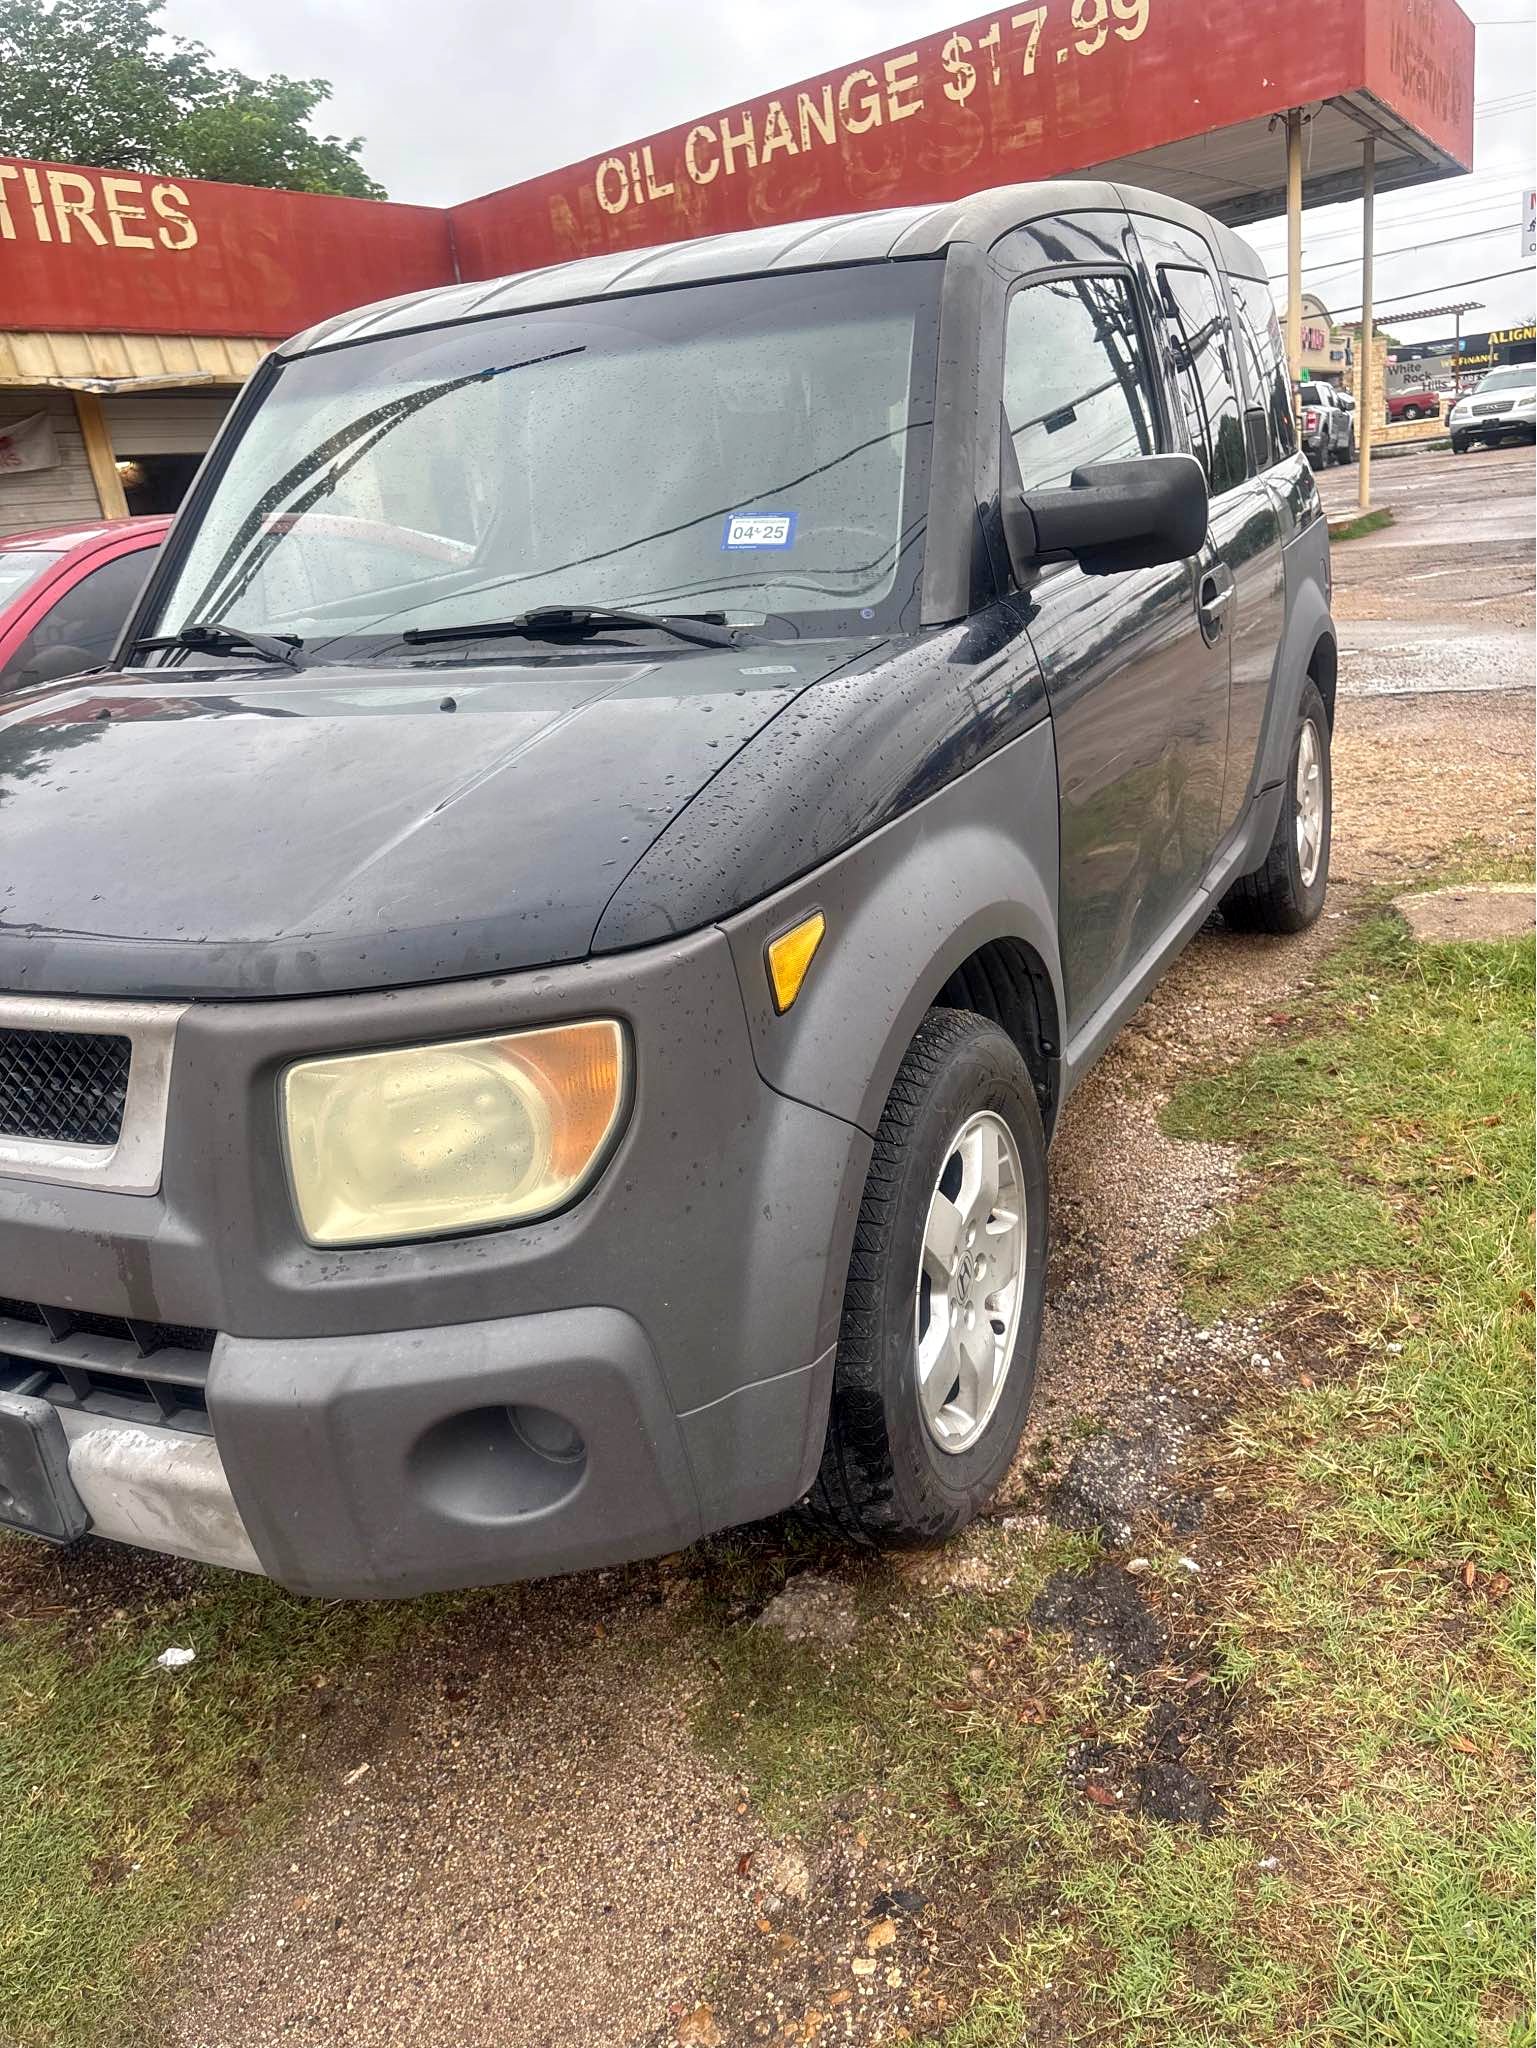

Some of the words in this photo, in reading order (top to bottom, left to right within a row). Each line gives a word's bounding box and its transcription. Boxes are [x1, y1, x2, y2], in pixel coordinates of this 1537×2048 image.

[595, 145, 675, 214] OIL
[685, 52, 925, 185] CHANGE
[941, 0, 1150, 108] $17.99
[0, 165, 199, 250] TIRES
[1488, 327, 1536, 345] ALIGN
[1387, 363, 1422, 376] White
[1403, 371, 1432, 384] Rock
[1422, 380, 1448, 392] Hills
